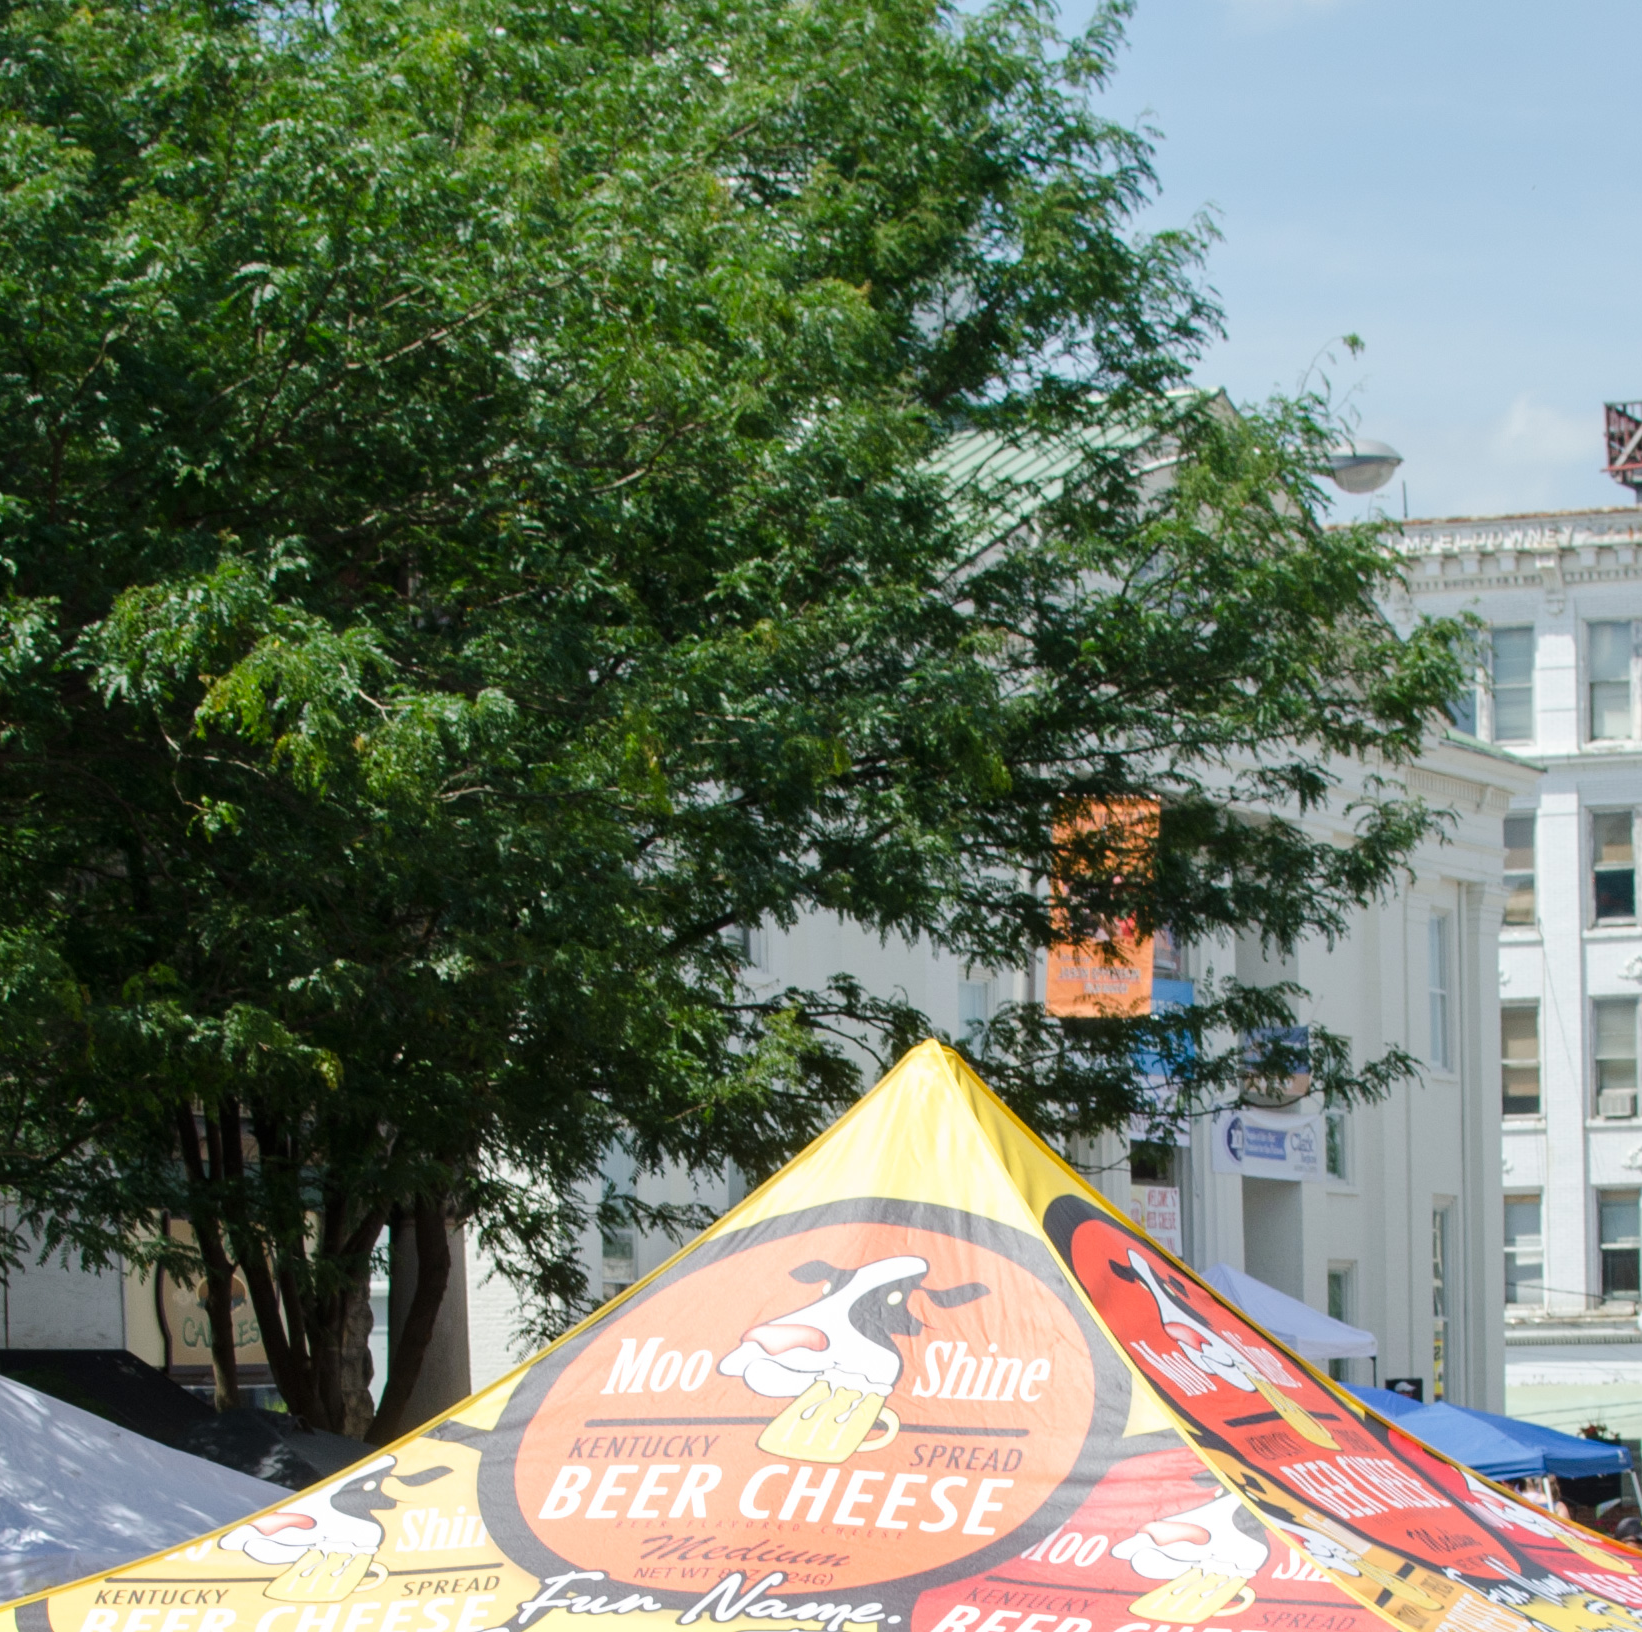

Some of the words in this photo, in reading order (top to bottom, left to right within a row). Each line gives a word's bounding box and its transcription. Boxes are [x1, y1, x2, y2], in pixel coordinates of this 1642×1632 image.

[600, 1337, 714, 1395] Moo
[911, 1338, 1052, 1402] Shine
[567, 1434, 719, 1460] KENTUCKY
[909, 1443, 1024, 1473] SPREAD
[538, 1463, 724, 1522] BEER
[738, 1463, 1014, 1537] CHEESE
[639, 1532, 851, 1568] Medium
[94, 1588, 230, 1605] KENTUCKY
[401, 1575, 501, 1597] SPREAD
[633, 1566, 672, 1580] NET
[676, 1566, 714, 1581] WT
[521, 1570, 661, 1622] Fun
[682, 1572, 902, 1631] Name.
[965, 1586, 1099, 1615] KENTUCKY
[1258, 1610, 1357, 1632] SPREAD
